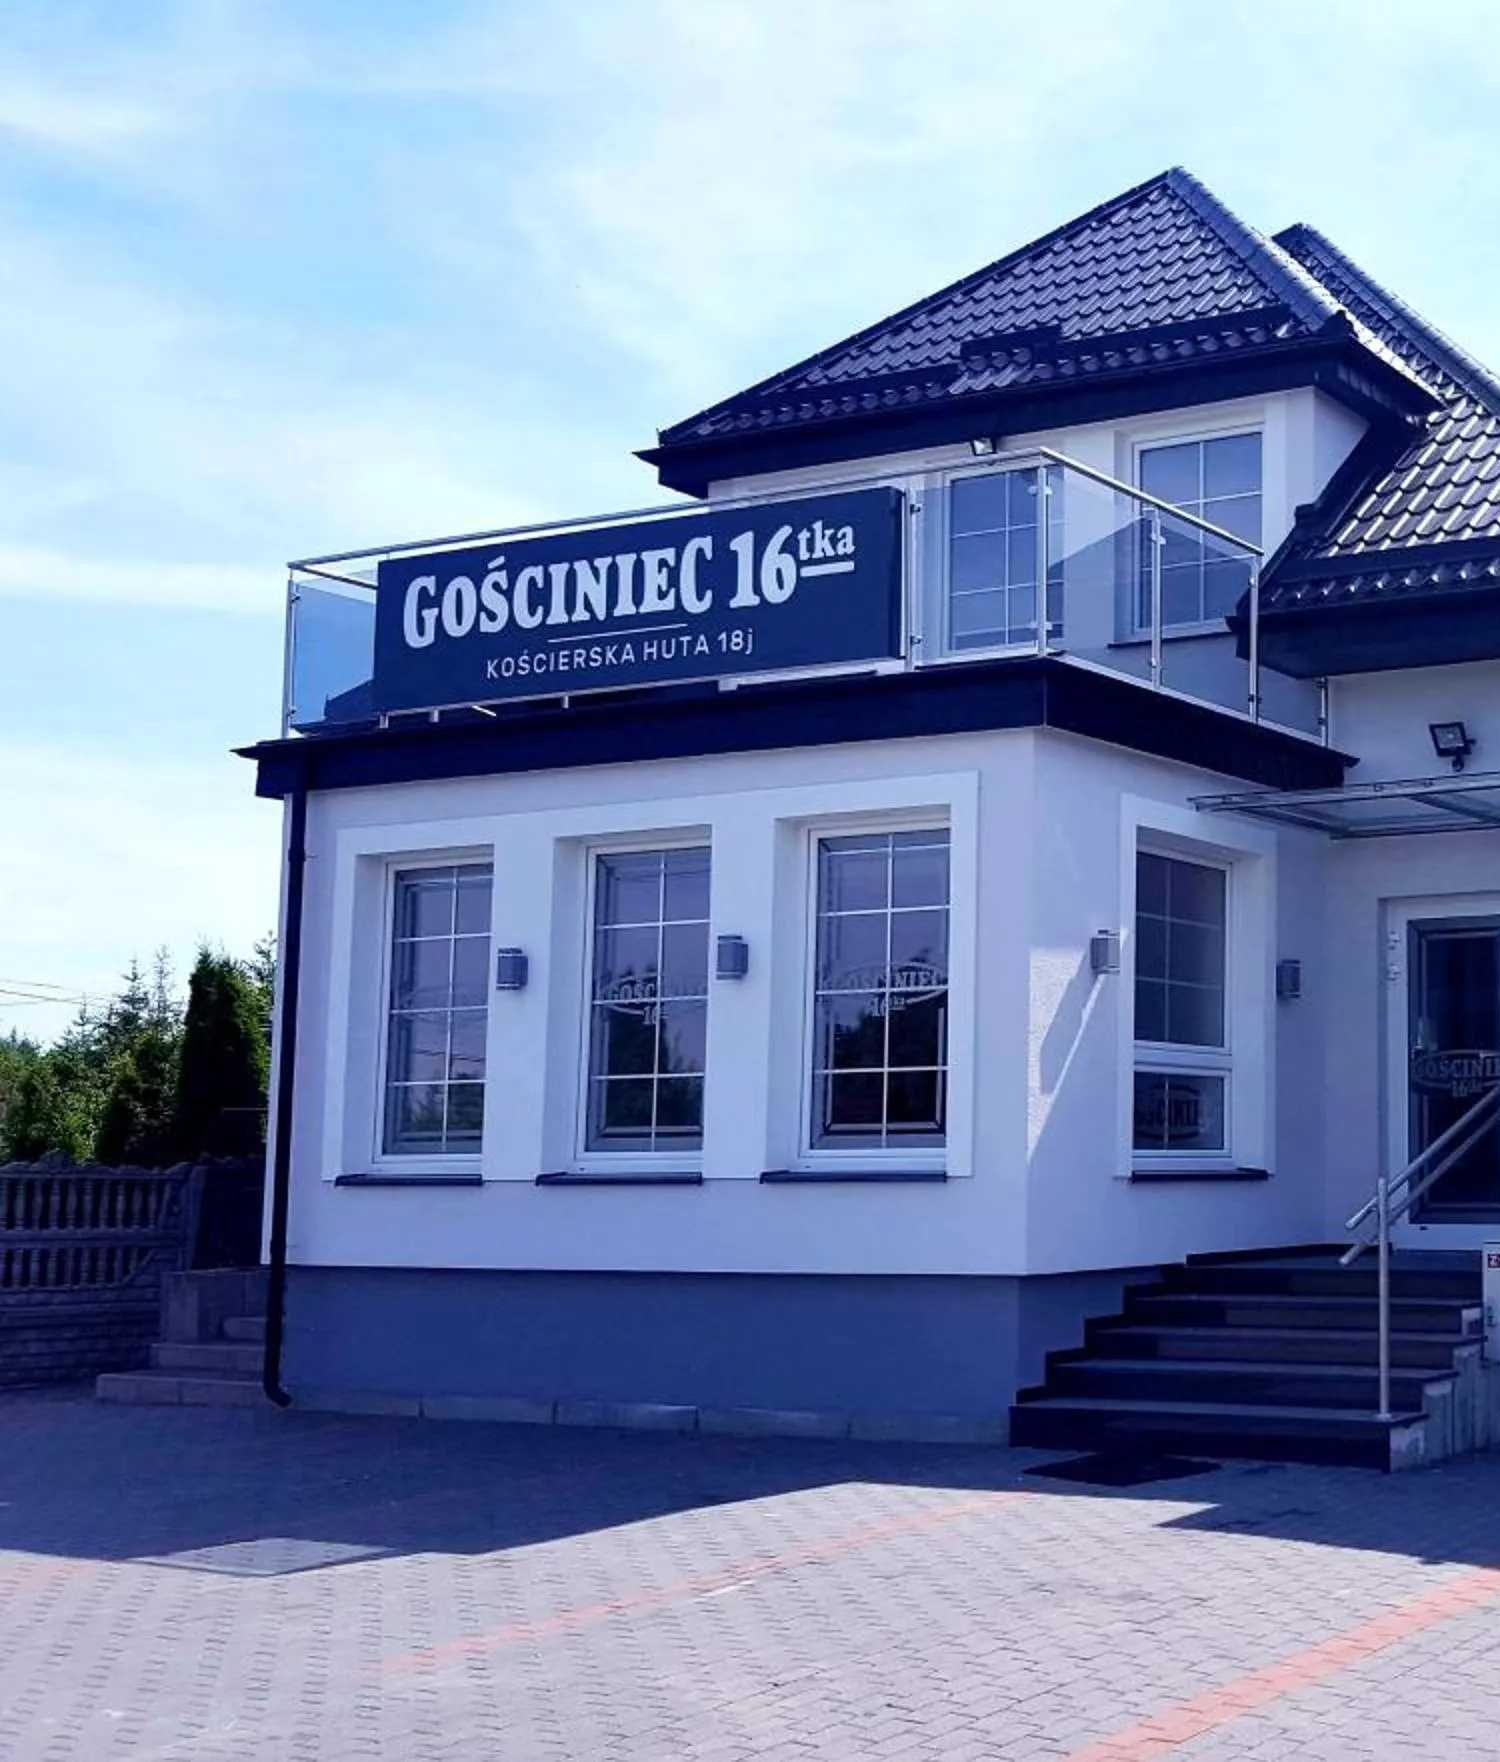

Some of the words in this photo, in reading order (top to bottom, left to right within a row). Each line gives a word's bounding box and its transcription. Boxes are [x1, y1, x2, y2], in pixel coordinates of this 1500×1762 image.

[402, 535, 714, 649] GOŚCINIEC
[486, 643, 636, 680] KOŚCIERSKA
[643, 633, 710, 661] HUTA
[717, 628, 753, 655] 18j
